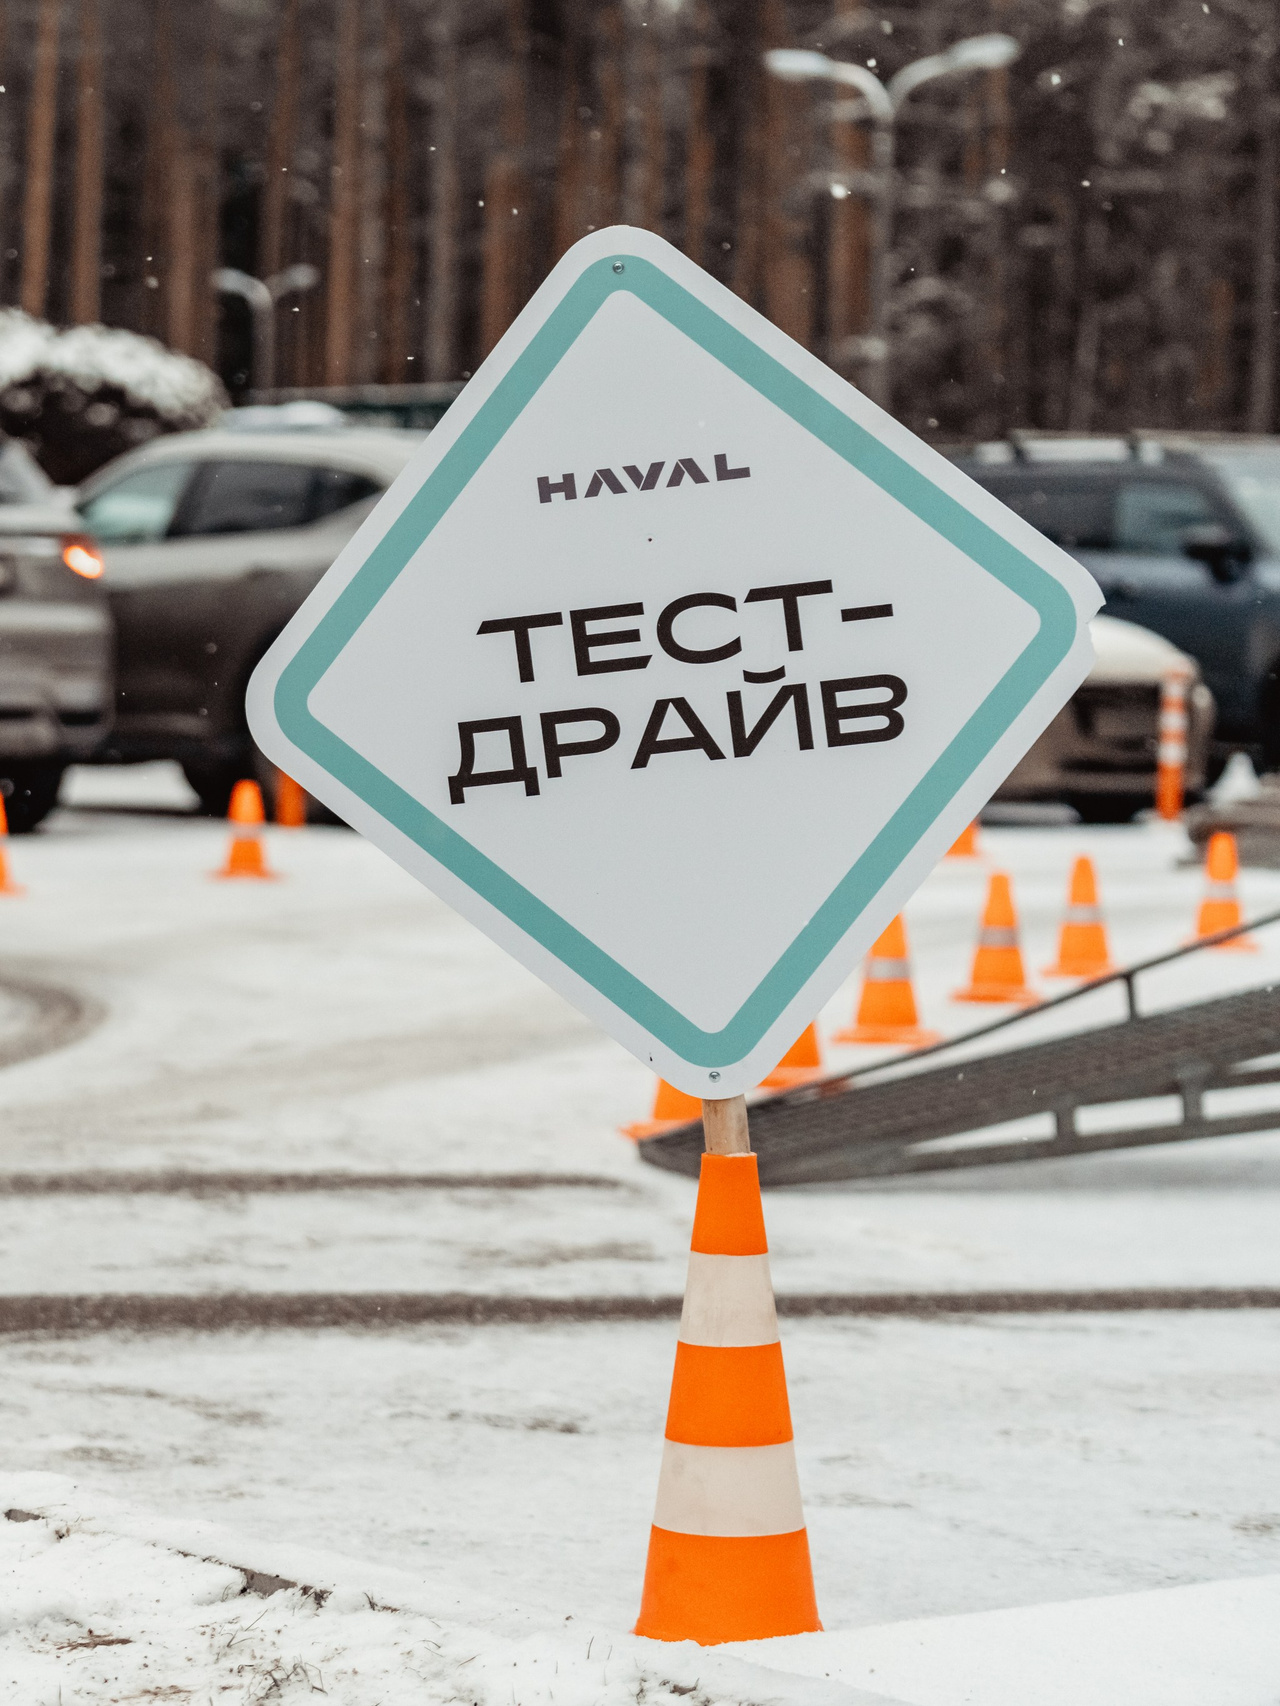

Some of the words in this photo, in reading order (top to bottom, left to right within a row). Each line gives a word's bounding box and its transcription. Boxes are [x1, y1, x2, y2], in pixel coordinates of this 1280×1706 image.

[536, 453, 751, 504] HAVAL
[476, 579, 894, 684] ТЕСТ-
[447, 665, 908, 806] ДРАЙВ
